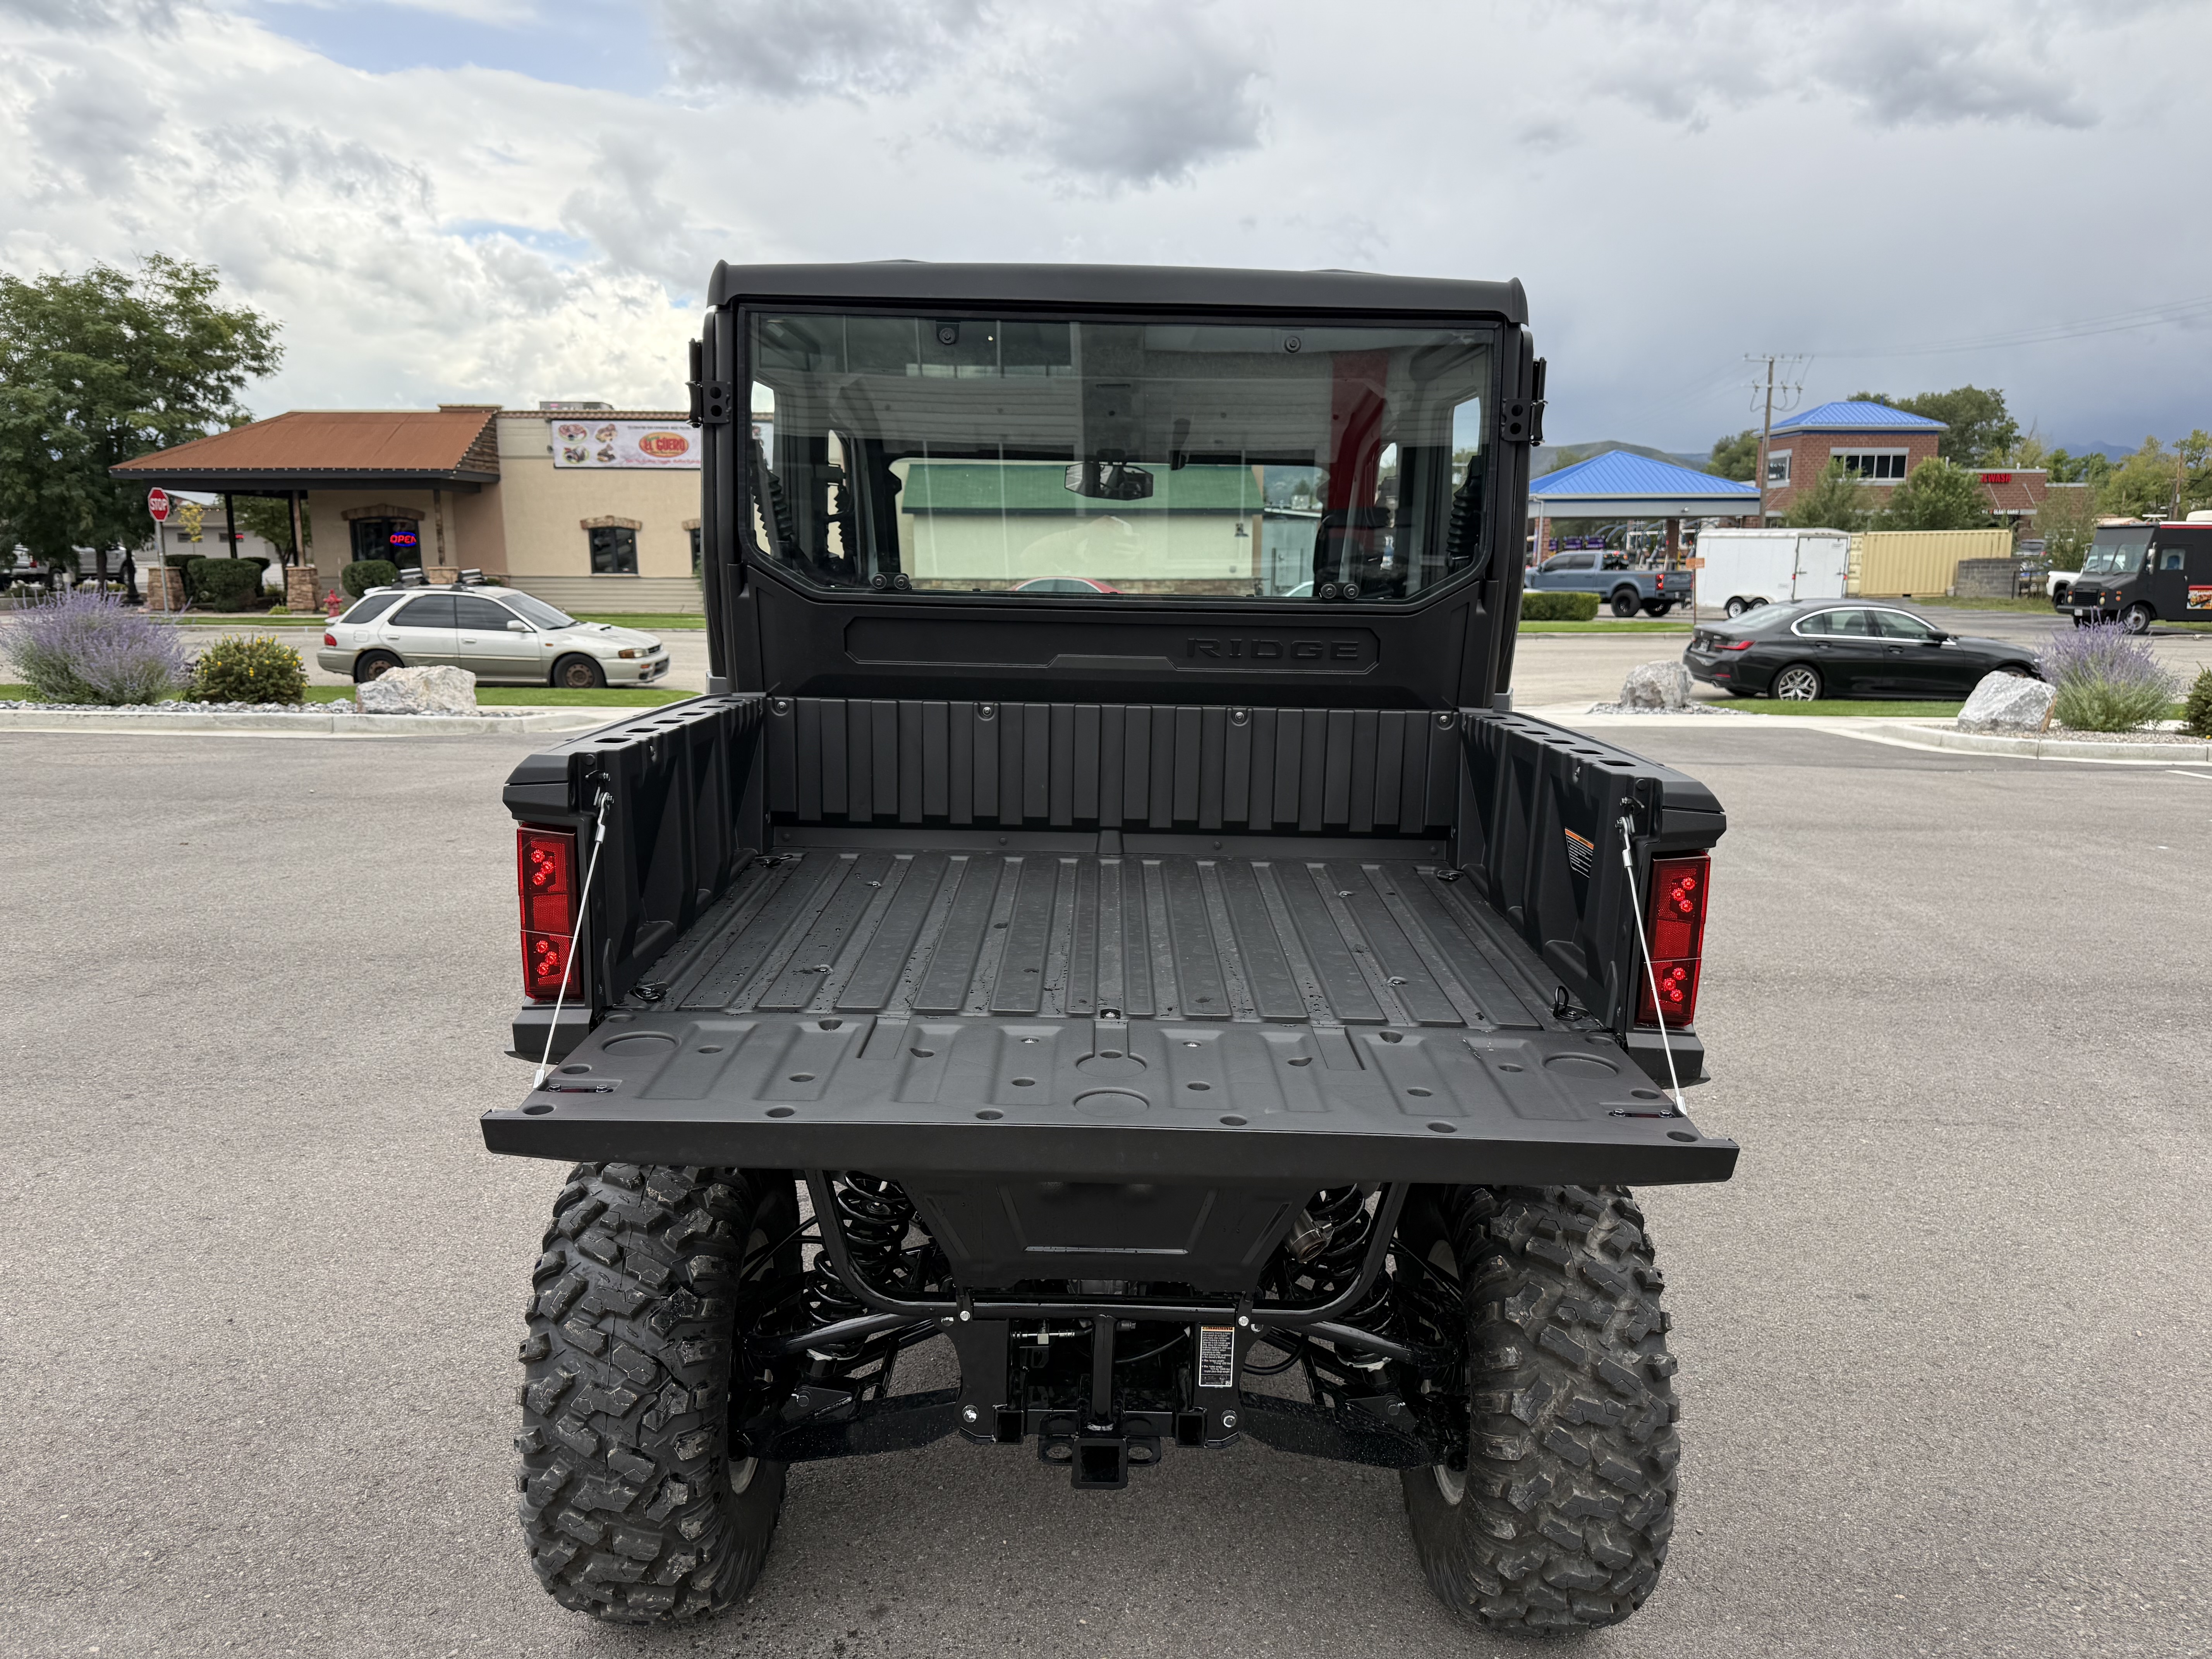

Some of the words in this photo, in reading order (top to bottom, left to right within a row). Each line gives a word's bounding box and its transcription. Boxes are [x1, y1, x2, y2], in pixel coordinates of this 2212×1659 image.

[1988, 473, 2011, 483] WASH
[150, 498, 168, 511] STOP
[1187, 638, 1359, 659] RIDGE
